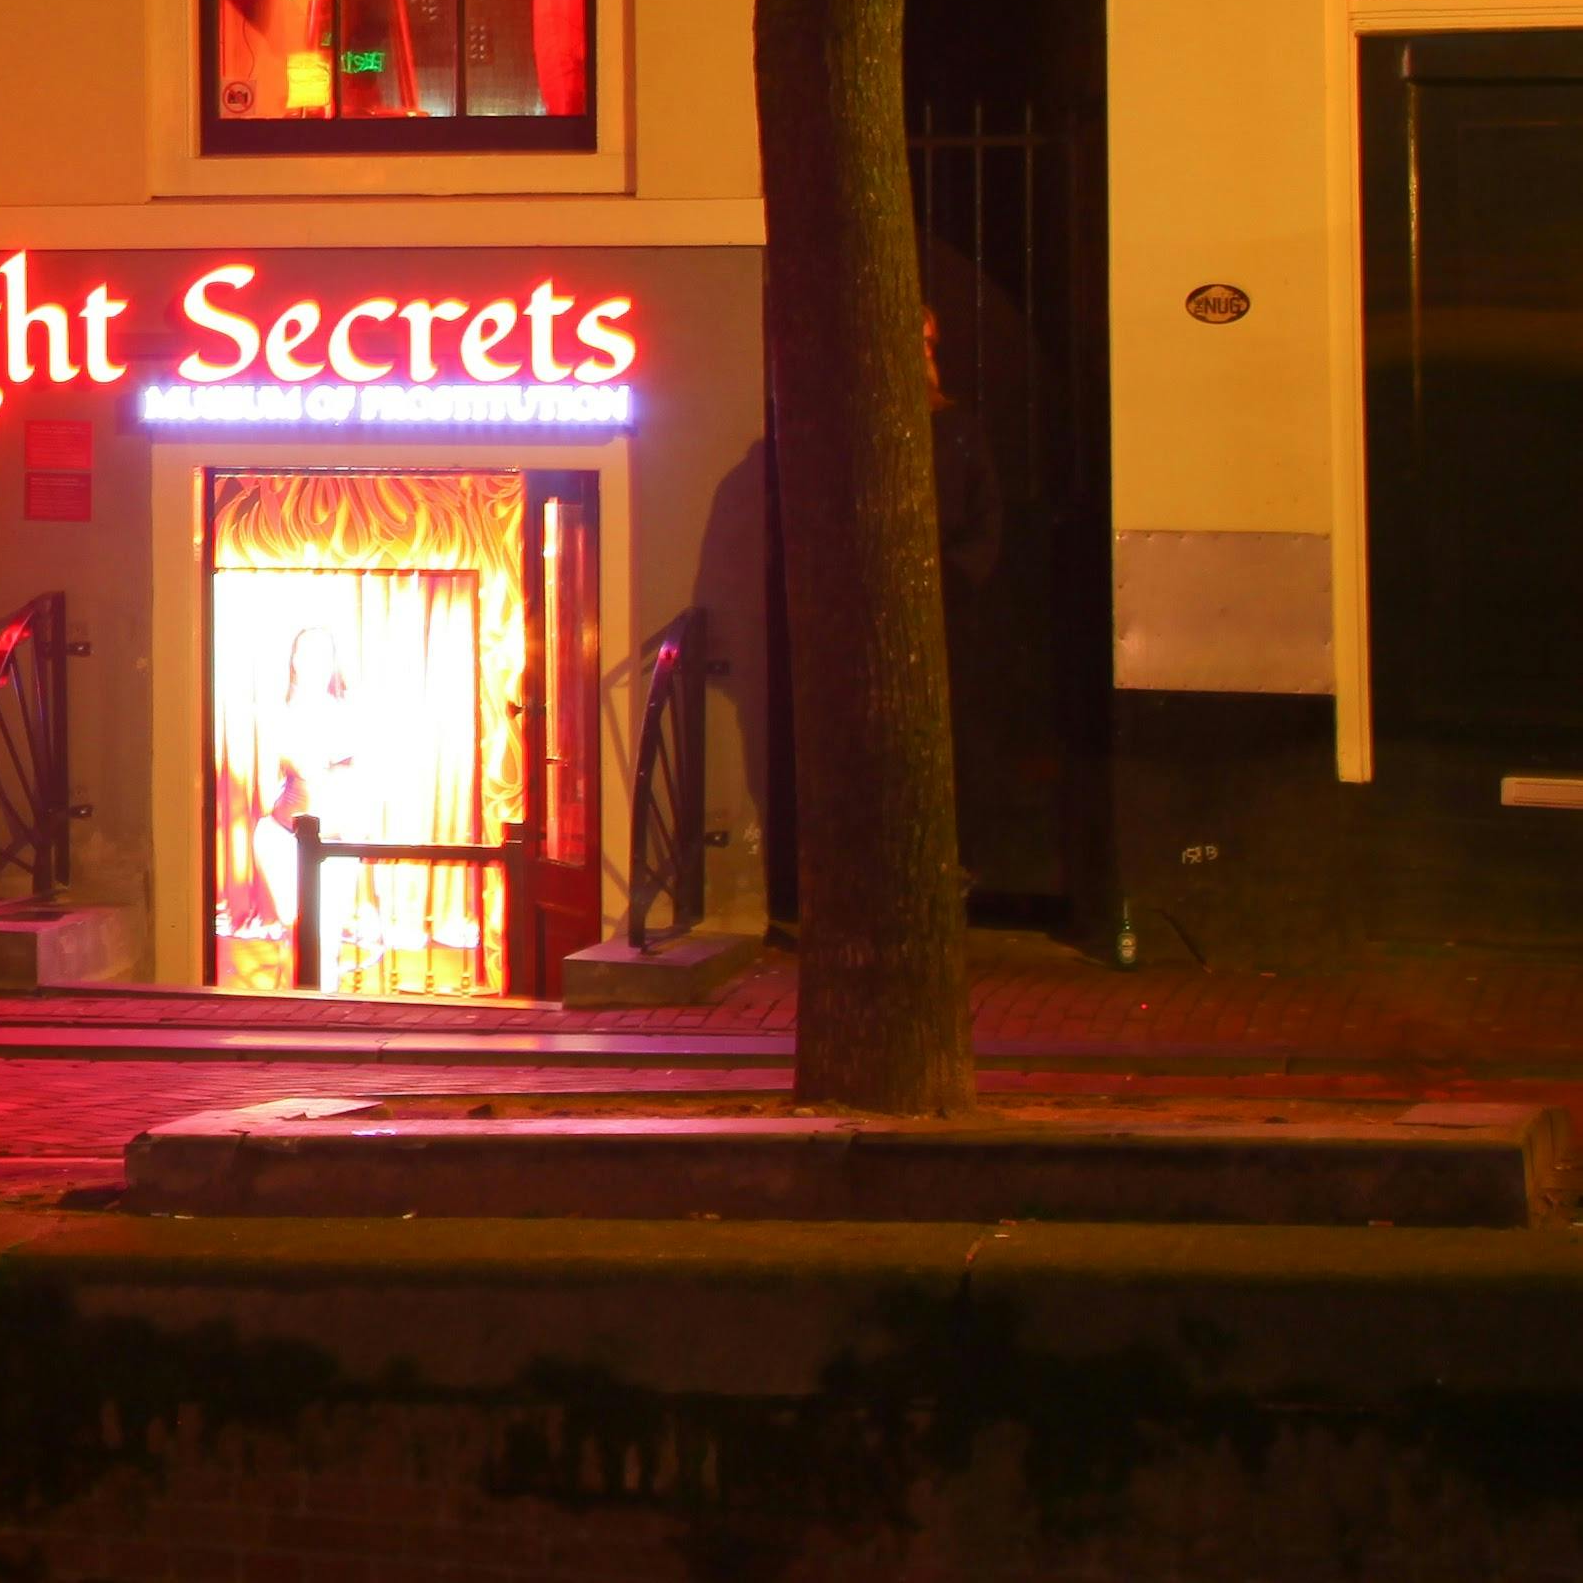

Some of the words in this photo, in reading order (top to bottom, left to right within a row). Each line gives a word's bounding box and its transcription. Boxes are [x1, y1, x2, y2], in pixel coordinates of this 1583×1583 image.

[178, 263, 636, 383] Secrets
[144, 384, 303, 421] MUSEUM
[305, 384, 356, 421] OF
[360, 384, 630, 421] PROSTITUTION
